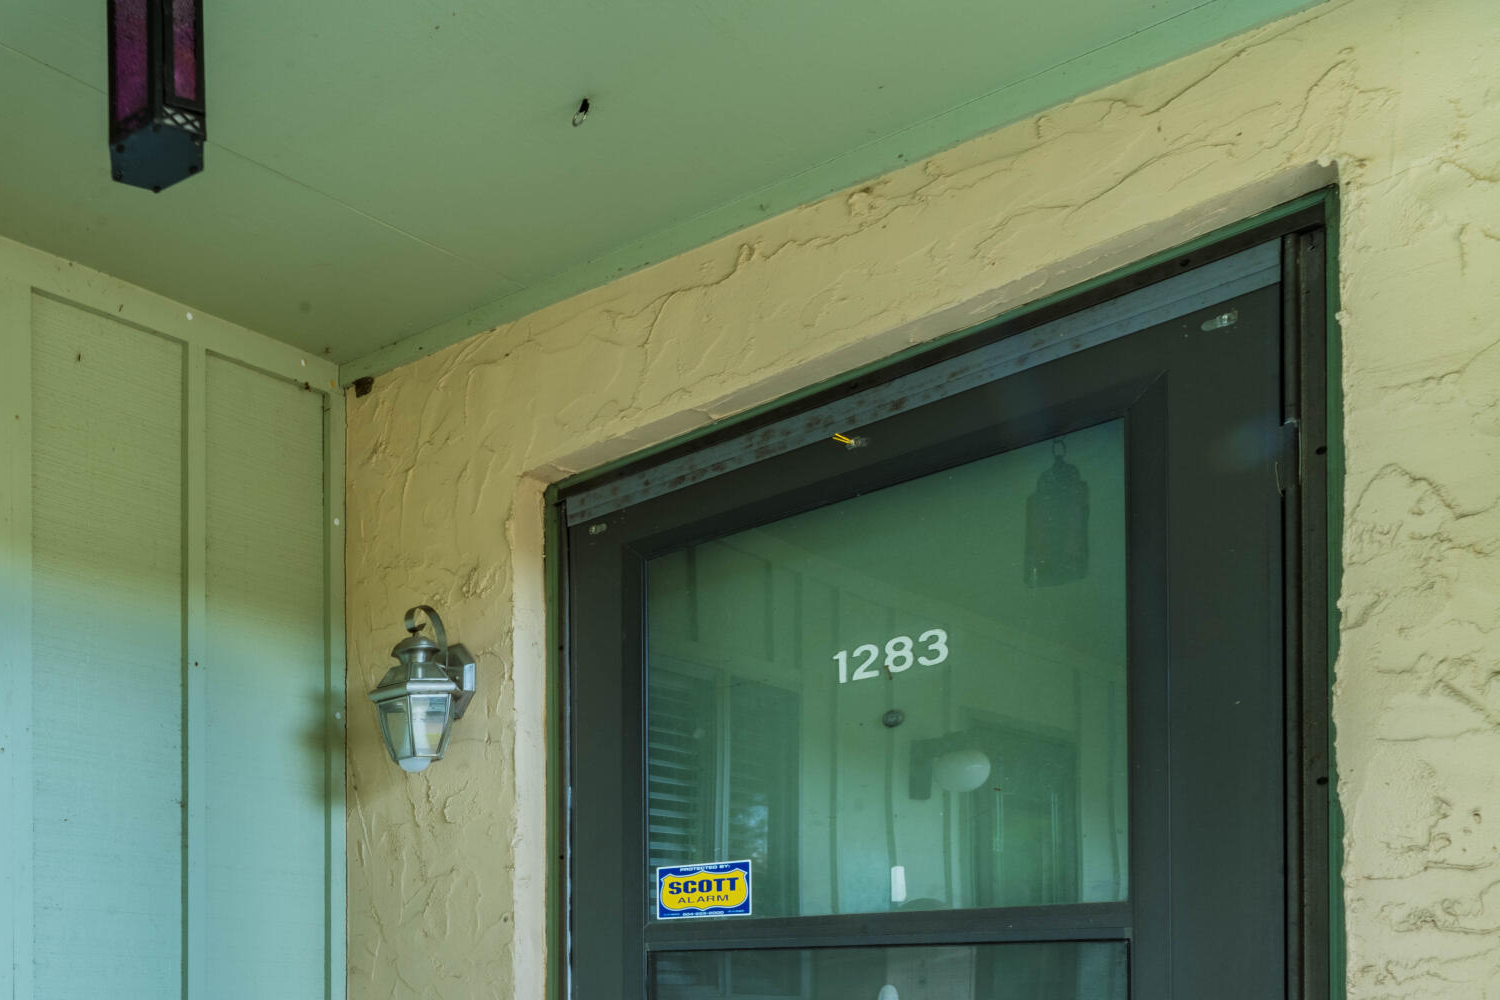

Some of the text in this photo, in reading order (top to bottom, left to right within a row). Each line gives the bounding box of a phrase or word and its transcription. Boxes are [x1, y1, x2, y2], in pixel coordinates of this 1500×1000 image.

[833, 629, 948, 683] 1283
[668, 877, 739, 895] SCOTT
[678, 895, 729, 904] ALARM
